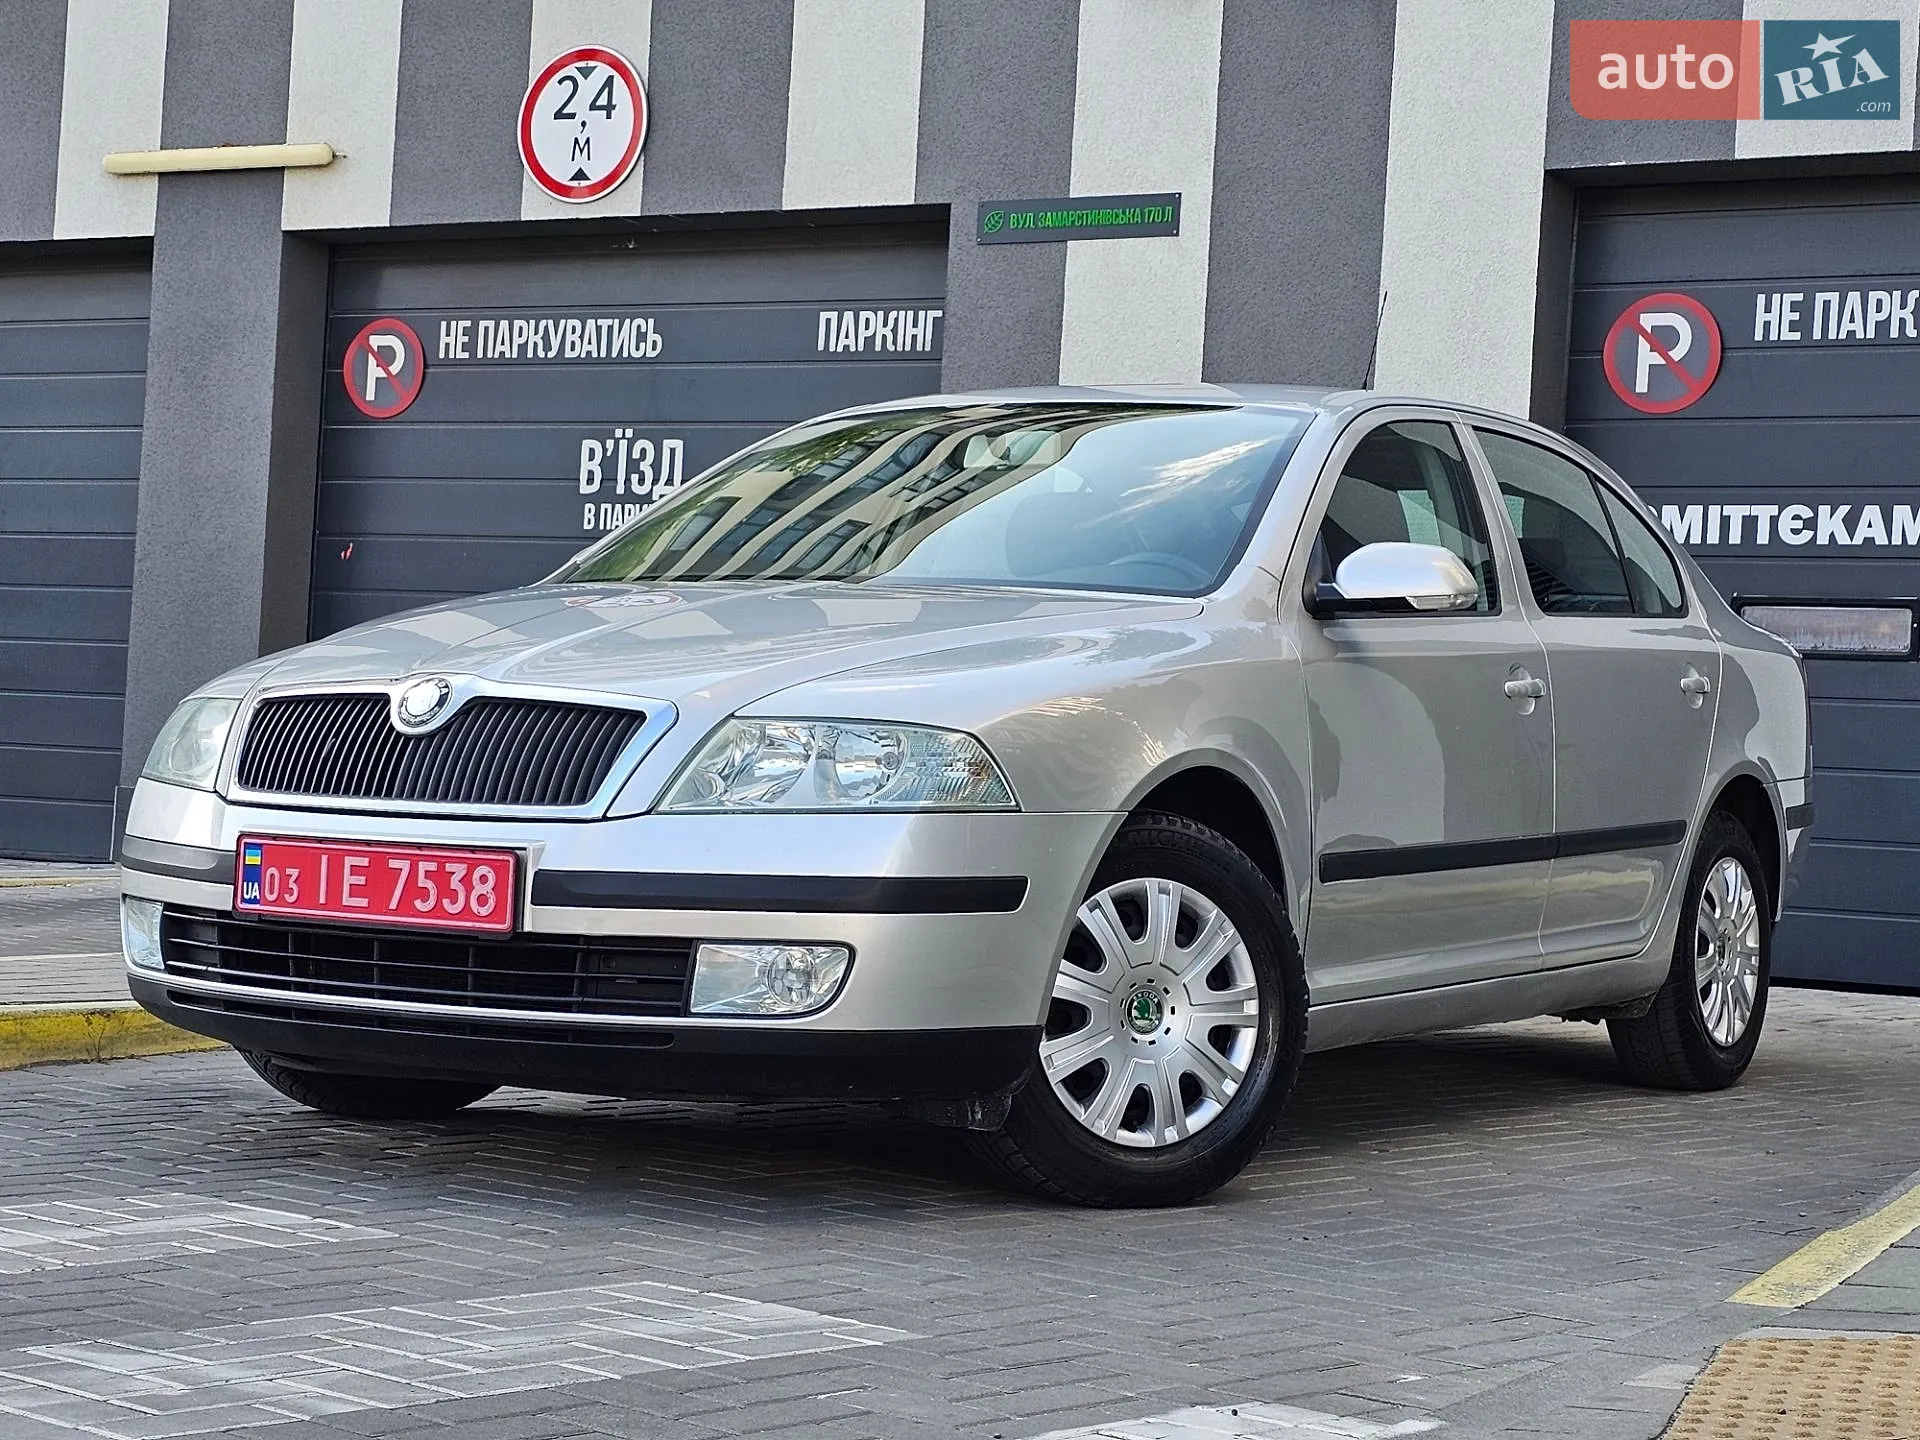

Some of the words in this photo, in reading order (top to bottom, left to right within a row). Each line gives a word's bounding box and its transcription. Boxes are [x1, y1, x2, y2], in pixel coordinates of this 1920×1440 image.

[553, 74, 617, 134] 2,4
[1038, 209, 1142, 228] ЗАМАРСТИНІВСЬКА
[1144, 207, 1162, 223] 170
[1163, 206, 1174, 222] Л
[817, 310, 943, 352] ПАРКІНГ
[1754, 292, 1804, 341] НЕ
[1812, 289, 1920, 340] ПАРК
[439, 320, 471, 359] НЕ
[477, 318, 663, 359] ПАРКУВАТИСЬ
[583, 503, 595, 530] В
[1648, 504, 1920, 545] МІТТЄКАМ
[243, 882, 260, 900] UA
[264, 866, 300, 904] 03
[318, 854, 370, 908] IE
[387, 858, 497, 917] 7538
